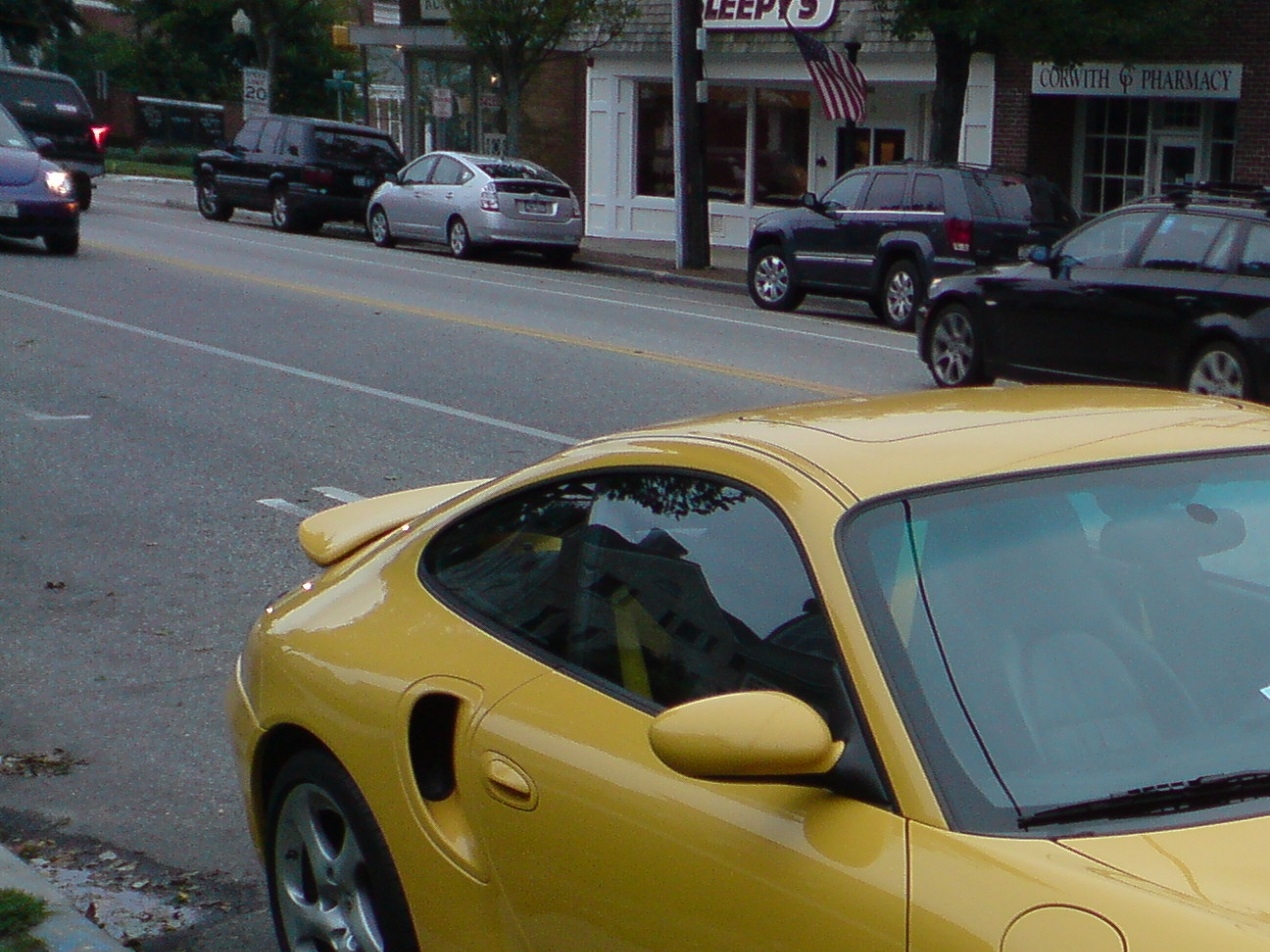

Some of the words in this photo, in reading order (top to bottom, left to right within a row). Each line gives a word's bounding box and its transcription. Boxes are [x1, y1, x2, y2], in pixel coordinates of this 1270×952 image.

[1039, 66, 1110, 89] CORWITH
[1142, 68, 1233, 91] PHARMACY
[244, 85, 268, 100] 20
